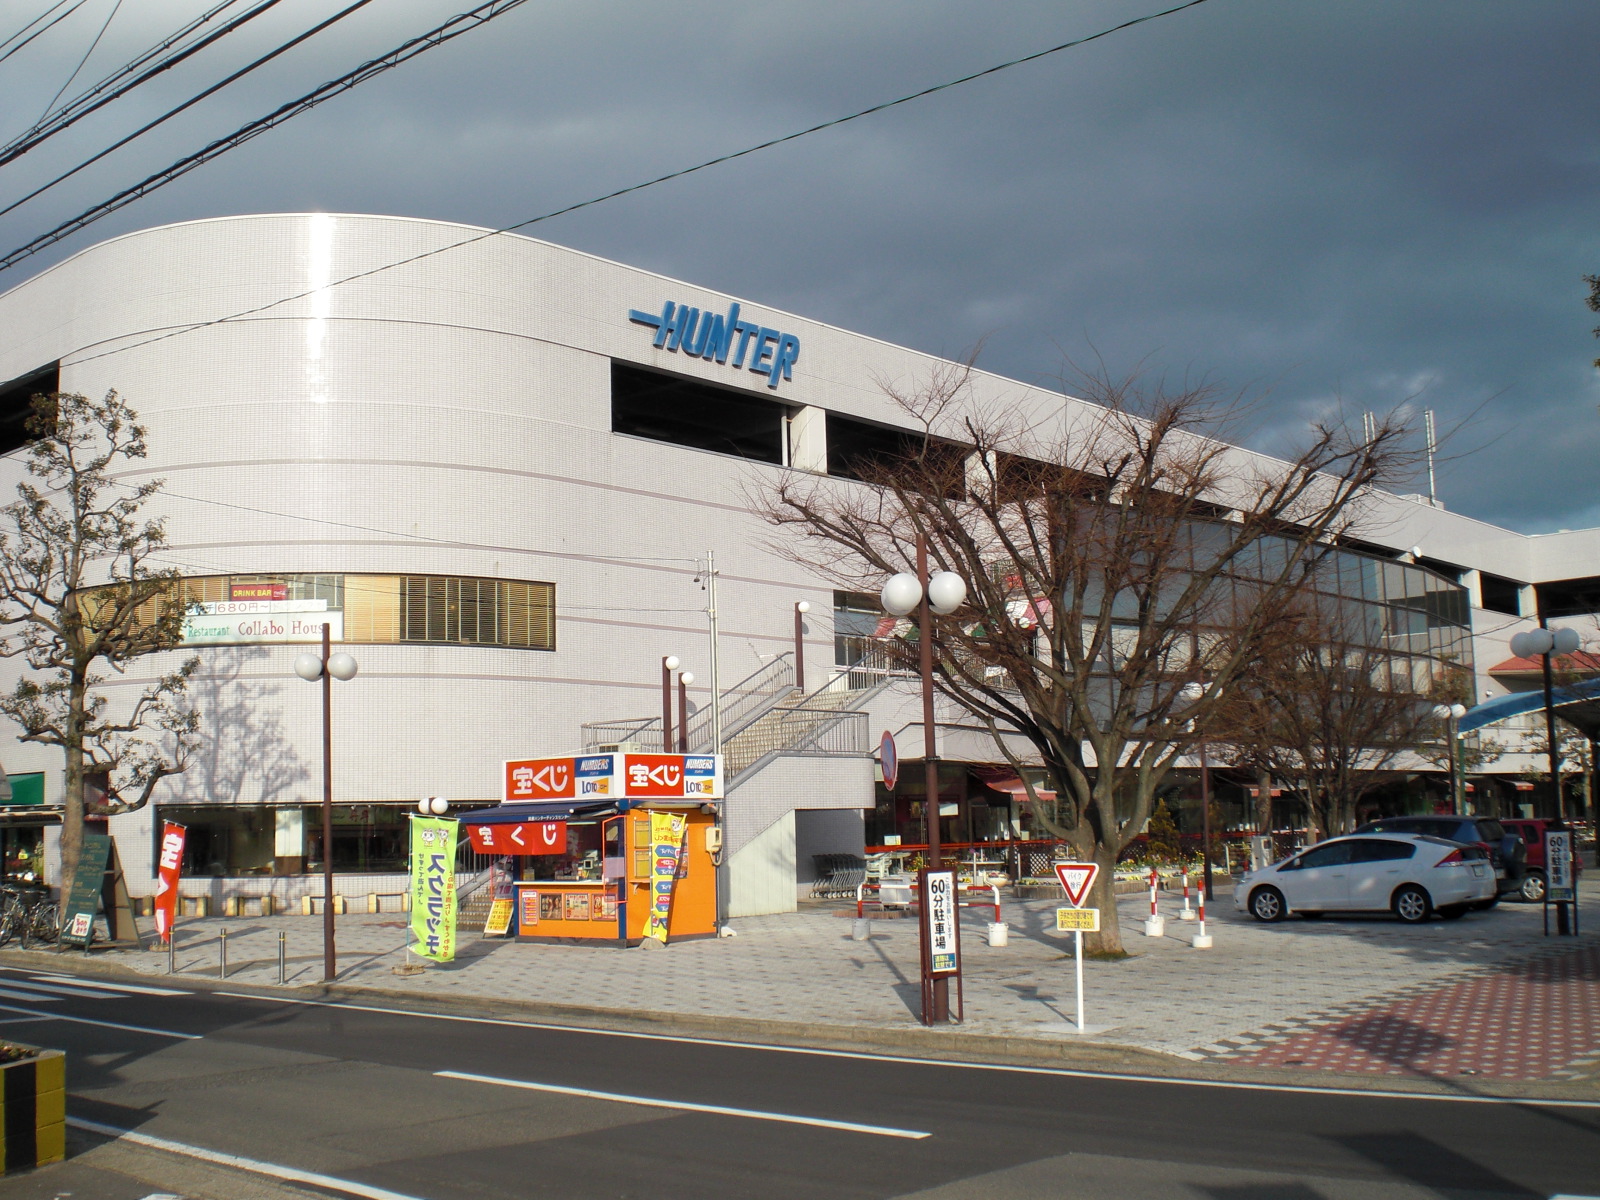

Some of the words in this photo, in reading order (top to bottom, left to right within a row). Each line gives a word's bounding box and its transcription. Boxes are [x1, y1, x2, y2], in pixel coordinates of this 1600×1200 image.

[629, 300, 801, 390] HUNTER
[233, 589, 255, 597] DRINK
[257, 589, 272, 597] BAR
[188, 625, 231, 638] Restaurant
[238, 620, 284, 636] Collabo
[291, 621, 326, 635] Hous
[580, 758, 610, 771] NUMBERS
[685, 758, 714, 770] NUMBERS
[512, 765, 568, 795] 宝くじ
[629, 763, 681, 788] 宝くじ
[582, 780, 598, 794] LOTO
[686, 780, 702, 793] LOTO
[1068, 872, 1082, 880] バイク
[931, 879, 947, 950] 60分駐車場
